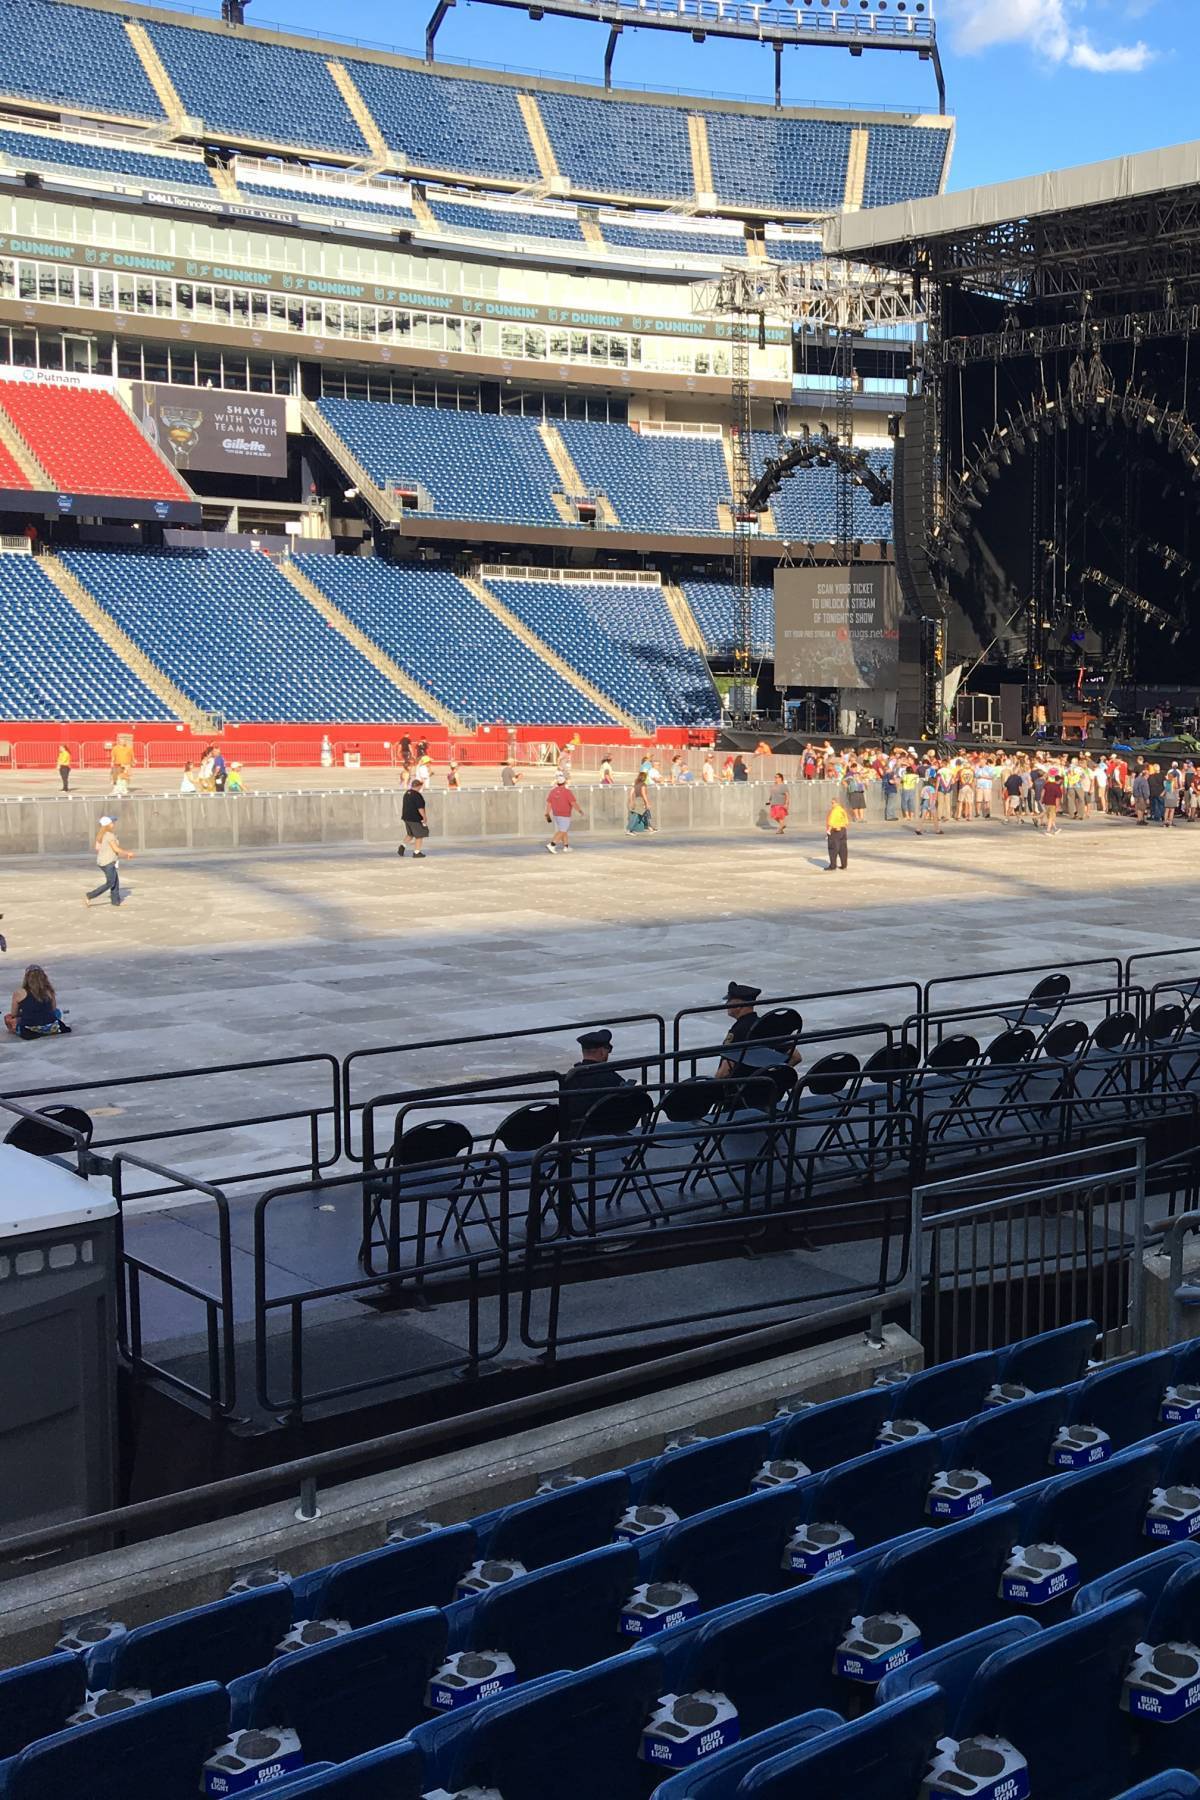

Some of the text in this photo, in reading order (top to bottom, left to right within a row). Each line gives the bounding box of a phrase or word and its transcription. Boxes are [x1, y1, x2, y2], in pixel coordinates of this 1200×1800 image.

[148, 193, 223, 212] DELL Technologies
[11, 239, 75, 259] DUNKIN'
[113, 254, 175, 273] DUNKIN'
[213, 267, 272, 285] DUNKIN'
[308, 279, 365, 297] DUNKIN'
[400, 292, 453, 309] DUNKIN'
[485, 304, 539, 319] DUNKIN'
[572, 312, 624, 327] DUNKIN'
[655, 320, 706, 334] DUNKIN'
[37, 372, 81, 385] Putnam
[226, 405, 265, 417] SHAVE
[214, 413, 277, 427] WITH YOUR
[215, 422, 277, 436] TEAM WITH
[222, 438, 265, 452] Gillette
[817, 583, 873, 594] SCAN YOUR TICKET
[812, 598, 820, 609] TO
[821, 598, 845, 609] UNLOCK
[851, 598, 876, 609] STREAM
[814, 613, 822, 624] OF
[855, 613, 874, 624] SHOW
[1152, 1528, 1171, 1536] LIGHT
[1048, 1580, 1068, 1594] LIGHT
[1051, 1574, 1066, 1587] BUD
[1009, 1590, 1029, 1598] LIGHT
[846, 1660, 861, 1668] BUD
[885, 1654, 909, 1671] LIGHT
[844, 1665, 864, 1675] LIGHT
[1140, 1695, 1159, 1706] BUD
[1137, 1702, 1162, 1714] LIGHT
[700, 1730, 720, 1746] BUD
[654, 1744, 669, 1753] BUD
[697, 1736, 724, 1756] LIGHT
[651, 1751, 672, 1760] LIGHT
[994, 1779, 1015, 1797] BUD
